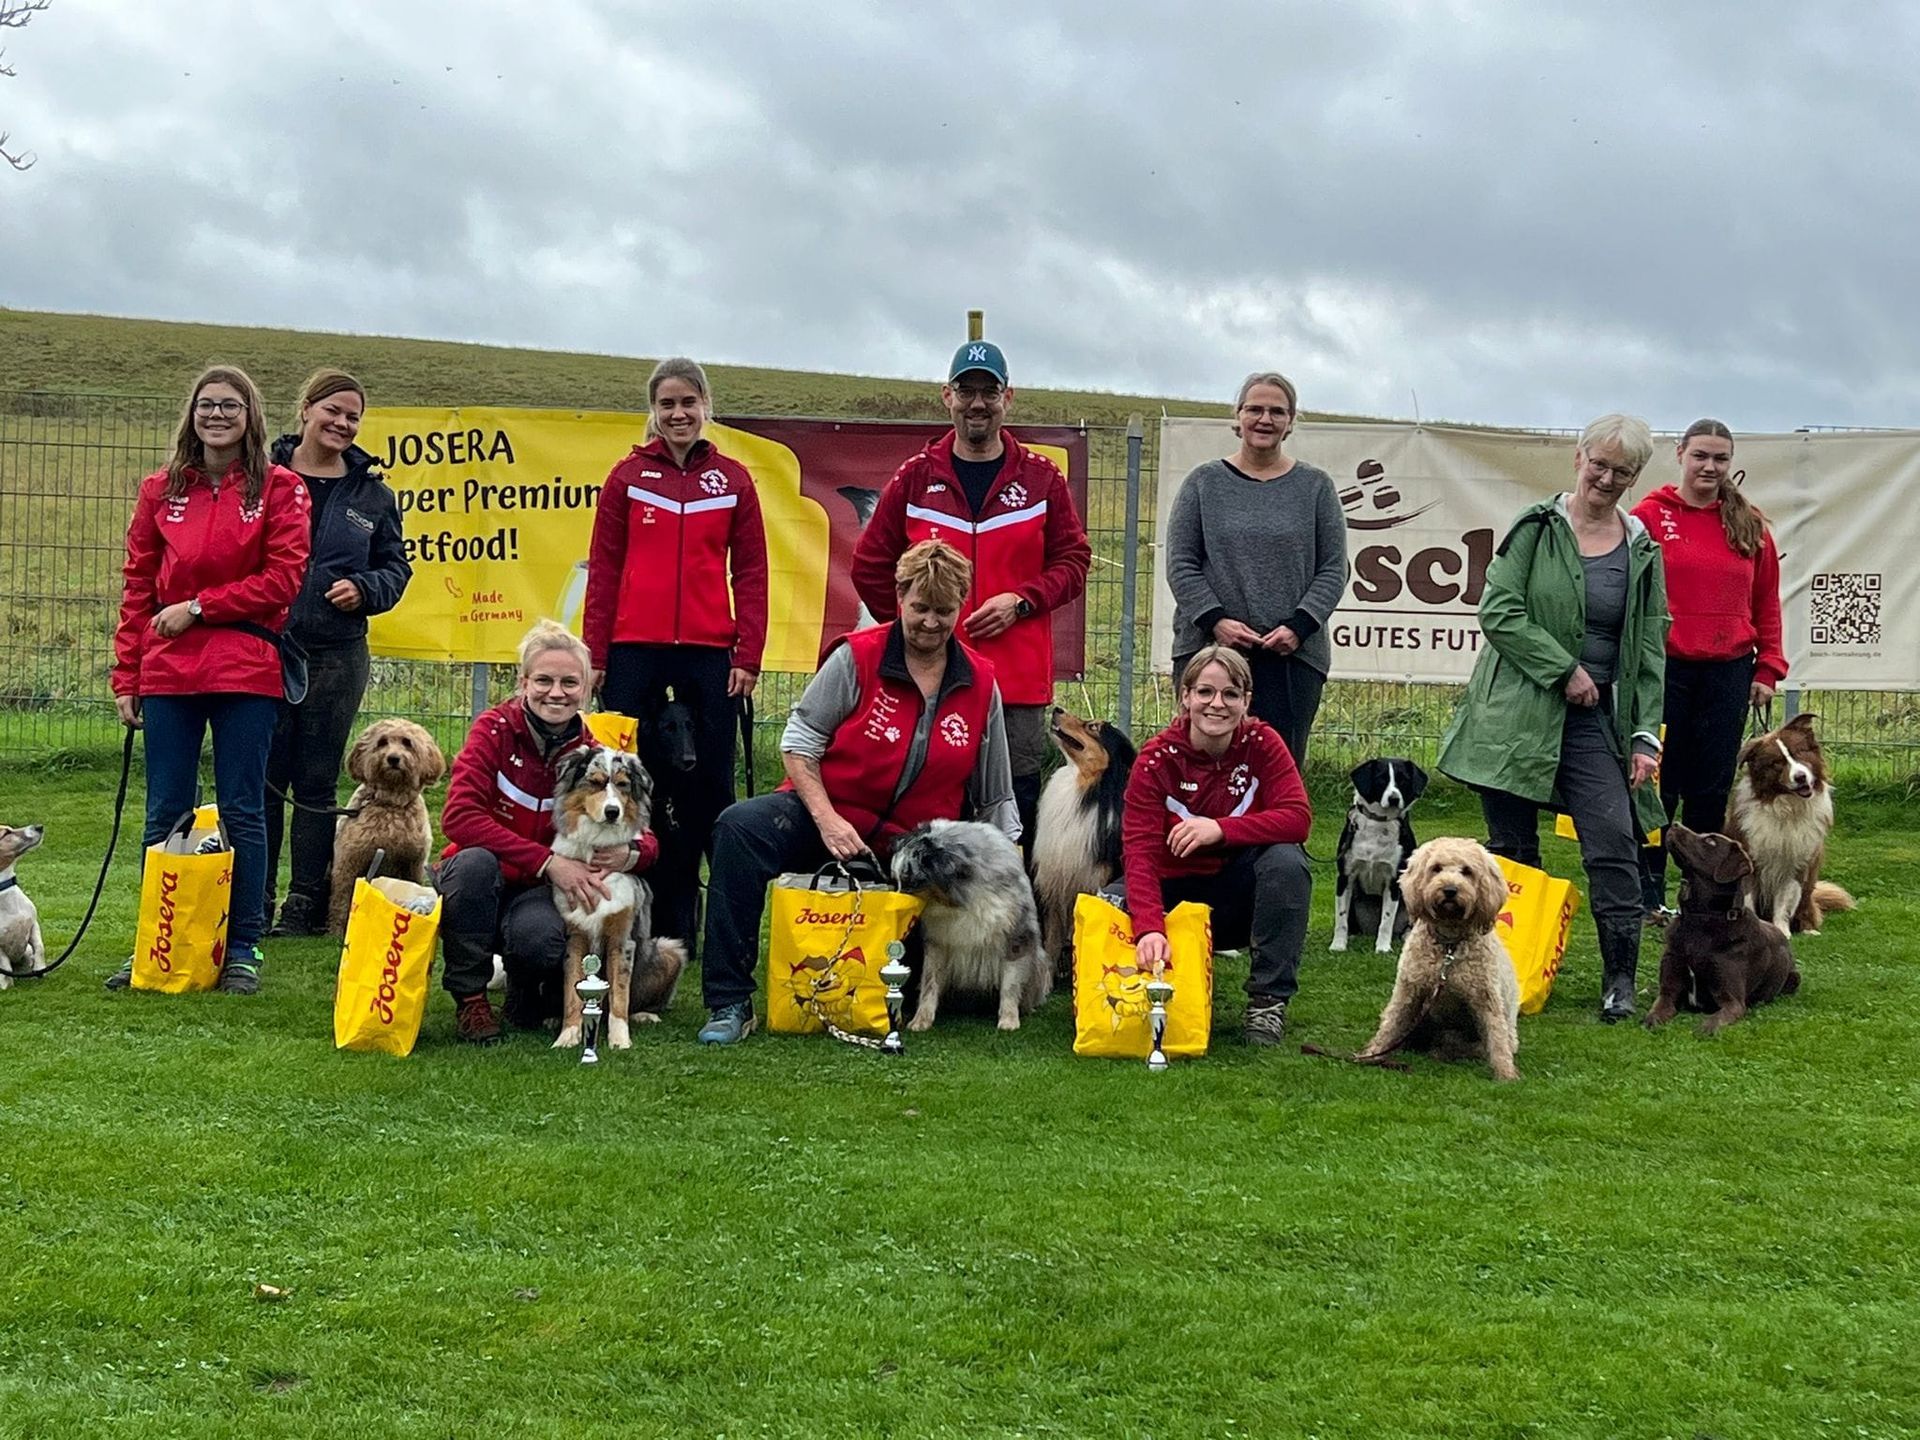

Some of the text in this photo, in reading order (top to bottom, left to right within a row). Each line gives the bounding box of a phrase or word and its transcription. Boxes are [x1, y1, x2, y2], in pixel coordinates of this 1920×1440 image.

[381, 429, 515, 470] JOSERA
[398, 486, 455, 522] per
[403, 528, 518, 562] etfood!
[472, 590, 504, 604] Made
[460, 608, 523, 623] in Germany
[1332, 625, 1481, 651] GUTES FUT
[150, 870, 179, 973] Josera
[794, 907, 867, 925] Josera
[370, 912, 412, 1025] Josera
